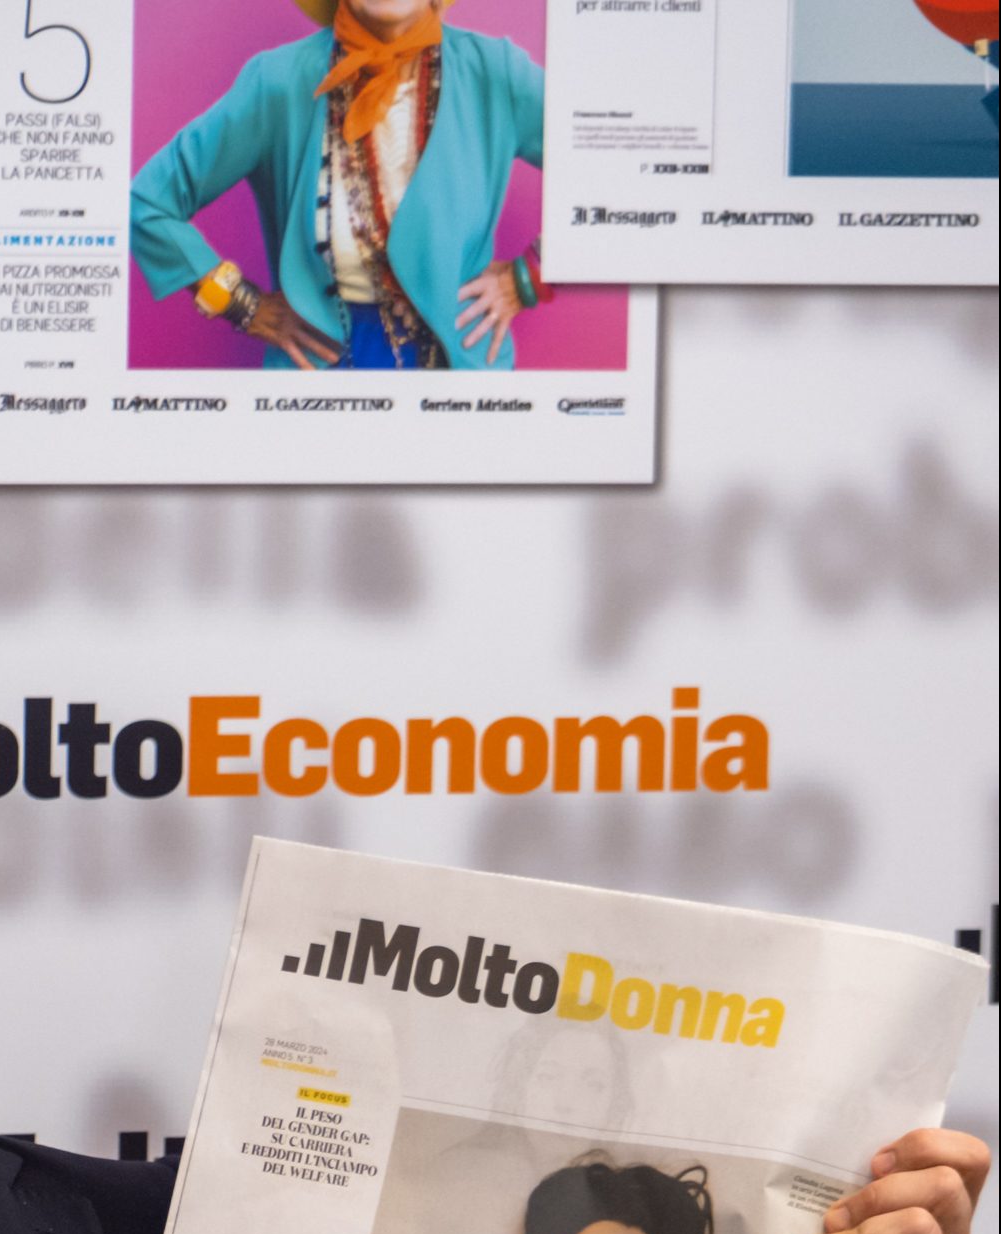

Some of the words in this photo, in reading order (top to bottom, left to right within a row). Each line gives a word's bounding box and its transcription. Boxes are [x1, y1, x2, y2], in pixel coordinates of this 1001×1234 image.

[20, 0, 92, 104] 5
[5, 113, 48, 127] PASSI
[52, 112, 102, 129] (FALSI)
[26, 131, 59, 145] NON
[62, 131, 114, 146] FANNO
[20, 149, 81, 163] SPARIRE
[1, 166, 20, 180] LA
[24, 166, 104, 181] PANCETTA
[590, 207, 677, 228] Messaggero
[702, 211, 719, 226] IL
[732, 211, 814, 227] MATTINO
[838, 212, 858, 227] IL
[860, 212, 980, 227] GAZZETTINO
[2, 265, 40, 279] PIZZA
[44, 265, 121, 279] PROMOSSA
[15, 283, 112, 297] NUTRIZIONISTI
[24, 300, 44, 314] UN
[47, 300, 89, 314] ELISIR
[0, 318, 13, 332] DI
[16, 318, 96, 332] BENESSERE
[112, 398, 130, 411] IL
[141, 398, 227, 411] MATTINO
[254, 398, 274, 411] IL
[276, 398, 394, 411] GAZZETTINO
[420, 398, 472, 412] Corriere
[475, 398, 532, 412] Adriatico
[348, 918, 785, 1048] MoltoDonna
[299, 1089, 309, 1097] IL
[313, 1090, 348, 1104] FOCUS
[295, 1106, 308, 1119] IL
[310, 1108, 342, 1125] PESO
[261, 1115, 286, 1130] DEL
[287, 1119, 338, 1139] GENDER
[339, 1129, 371, 1145] GAP:
[270, 1132, 287, 1145] SU
[288, 1135, 353, 1157] CARRIERA
[241, 1142, 249, 1153] E
[251, 1144, 302, 1163] REDDITI
[304, 1153, 378, 1177] L'INCIAMPO
[262, 1161, 287, 1176] DEL
[288, 1165, 349, 1187] WELFARE
